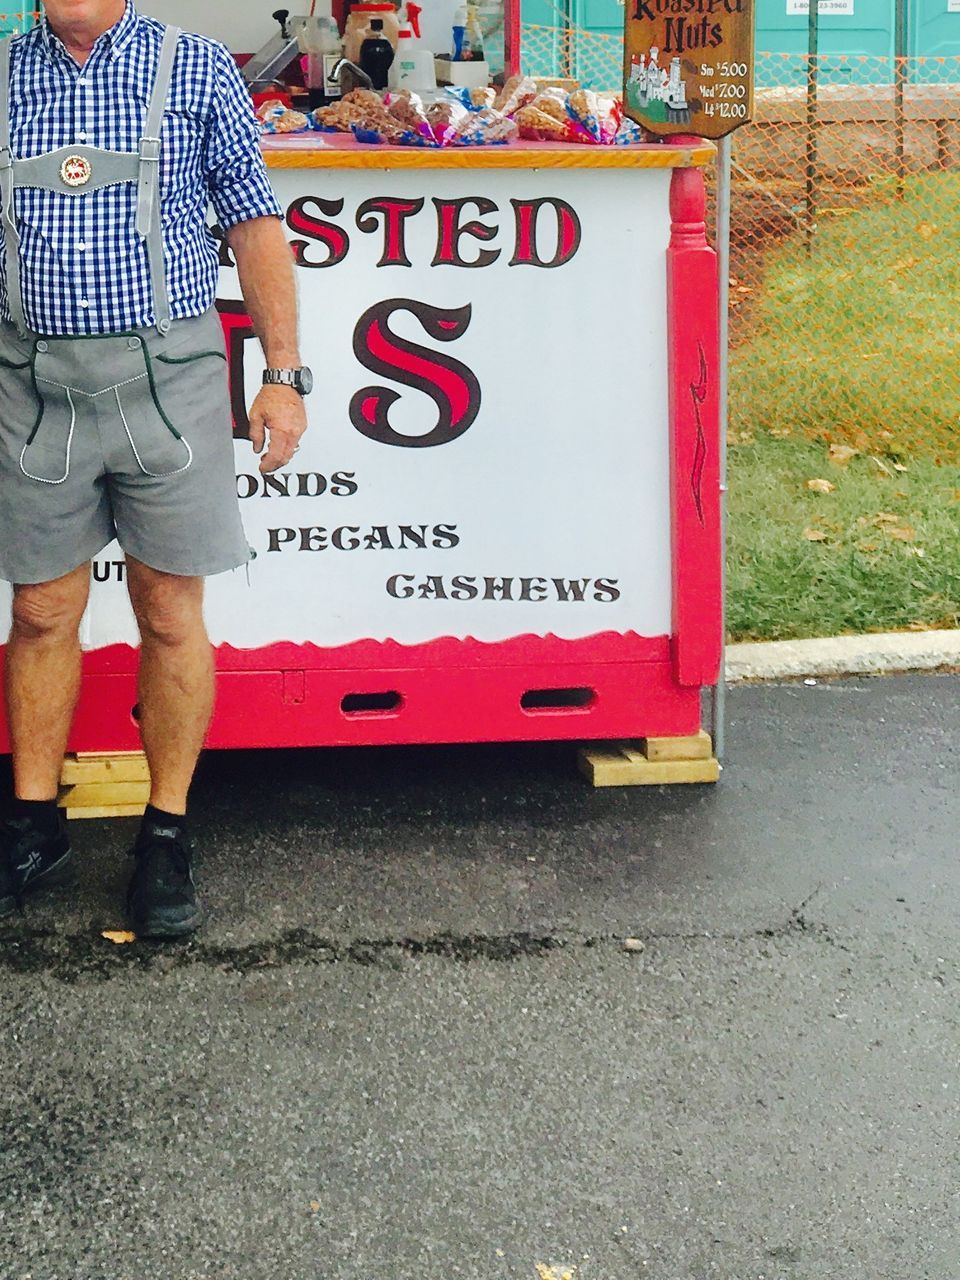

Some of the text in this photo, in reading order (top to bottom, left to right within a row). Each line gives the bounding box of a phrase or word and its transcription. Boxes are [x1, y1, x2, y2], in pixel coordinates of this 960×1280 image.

[662, 15, 723, 53] Nuts
[716, 62, 747, 77] $5.00
[210, 196, 581, 268] STED
[237, 471, 359, 499] ONDS
